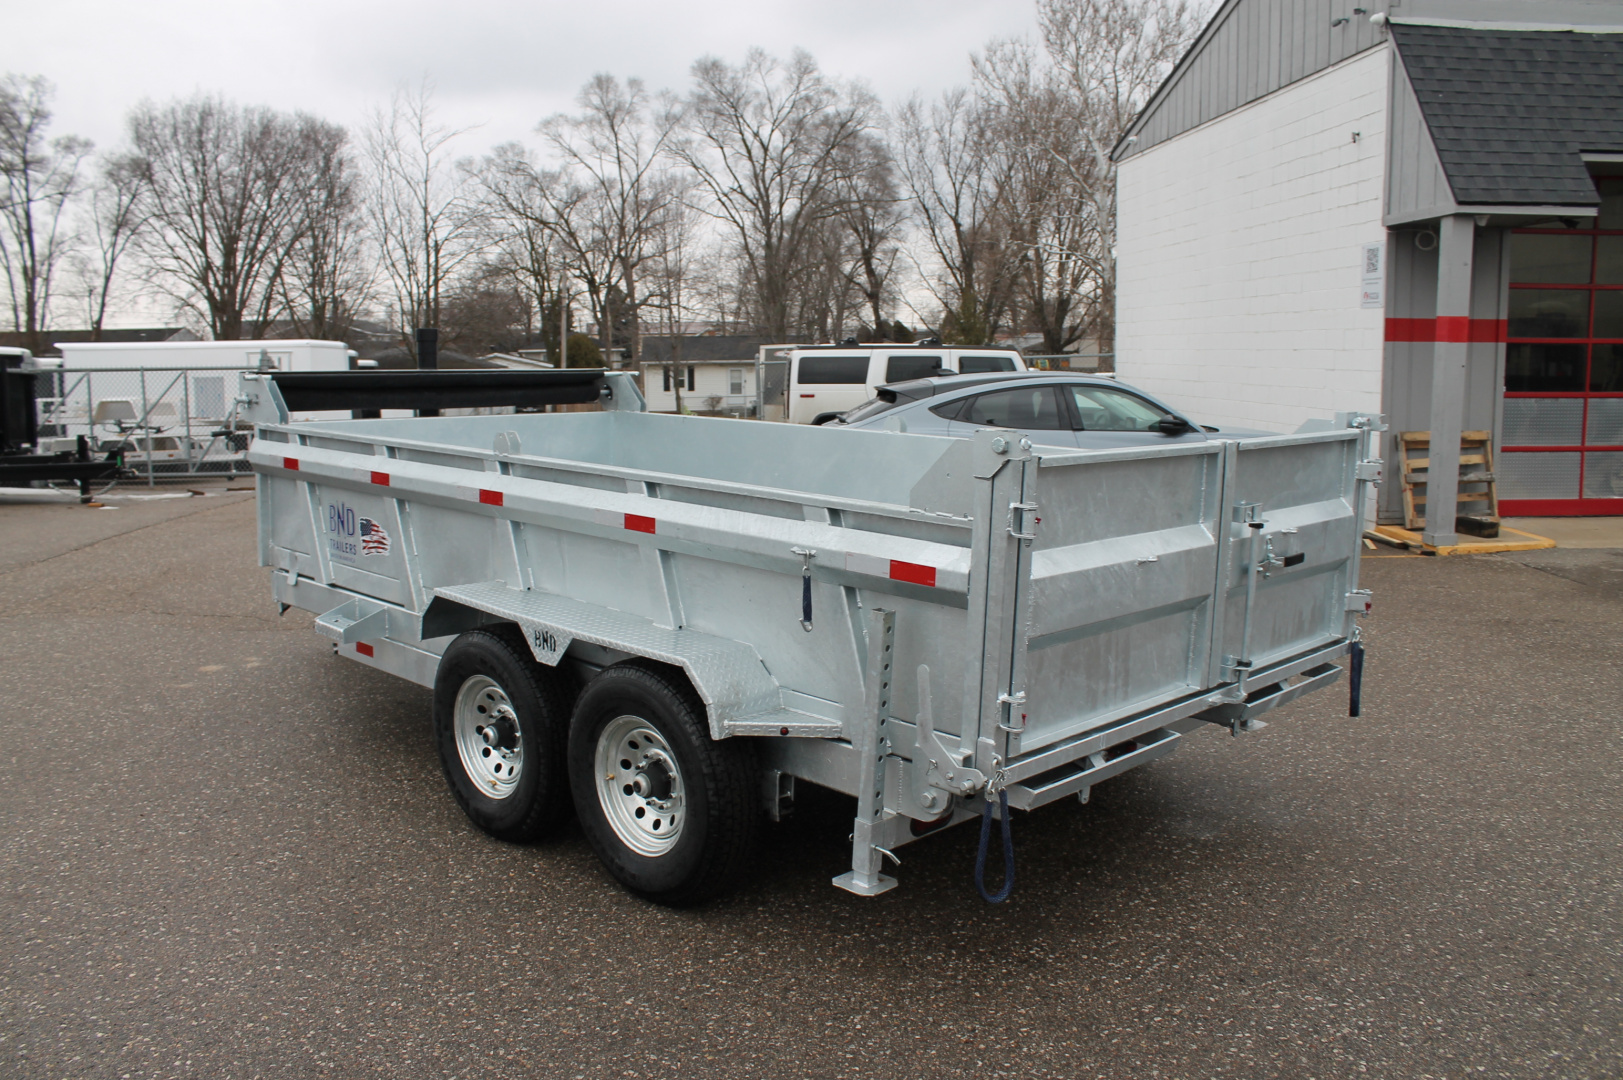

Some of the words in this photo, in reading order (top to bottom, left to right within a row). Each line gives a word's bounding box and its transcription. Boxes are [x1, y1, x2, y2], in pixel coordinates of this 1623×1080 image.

[329, 502, 355, 536] BND
[330, 538, 357, 556] TRAILERS
[534, 630, 557, 653] BND
